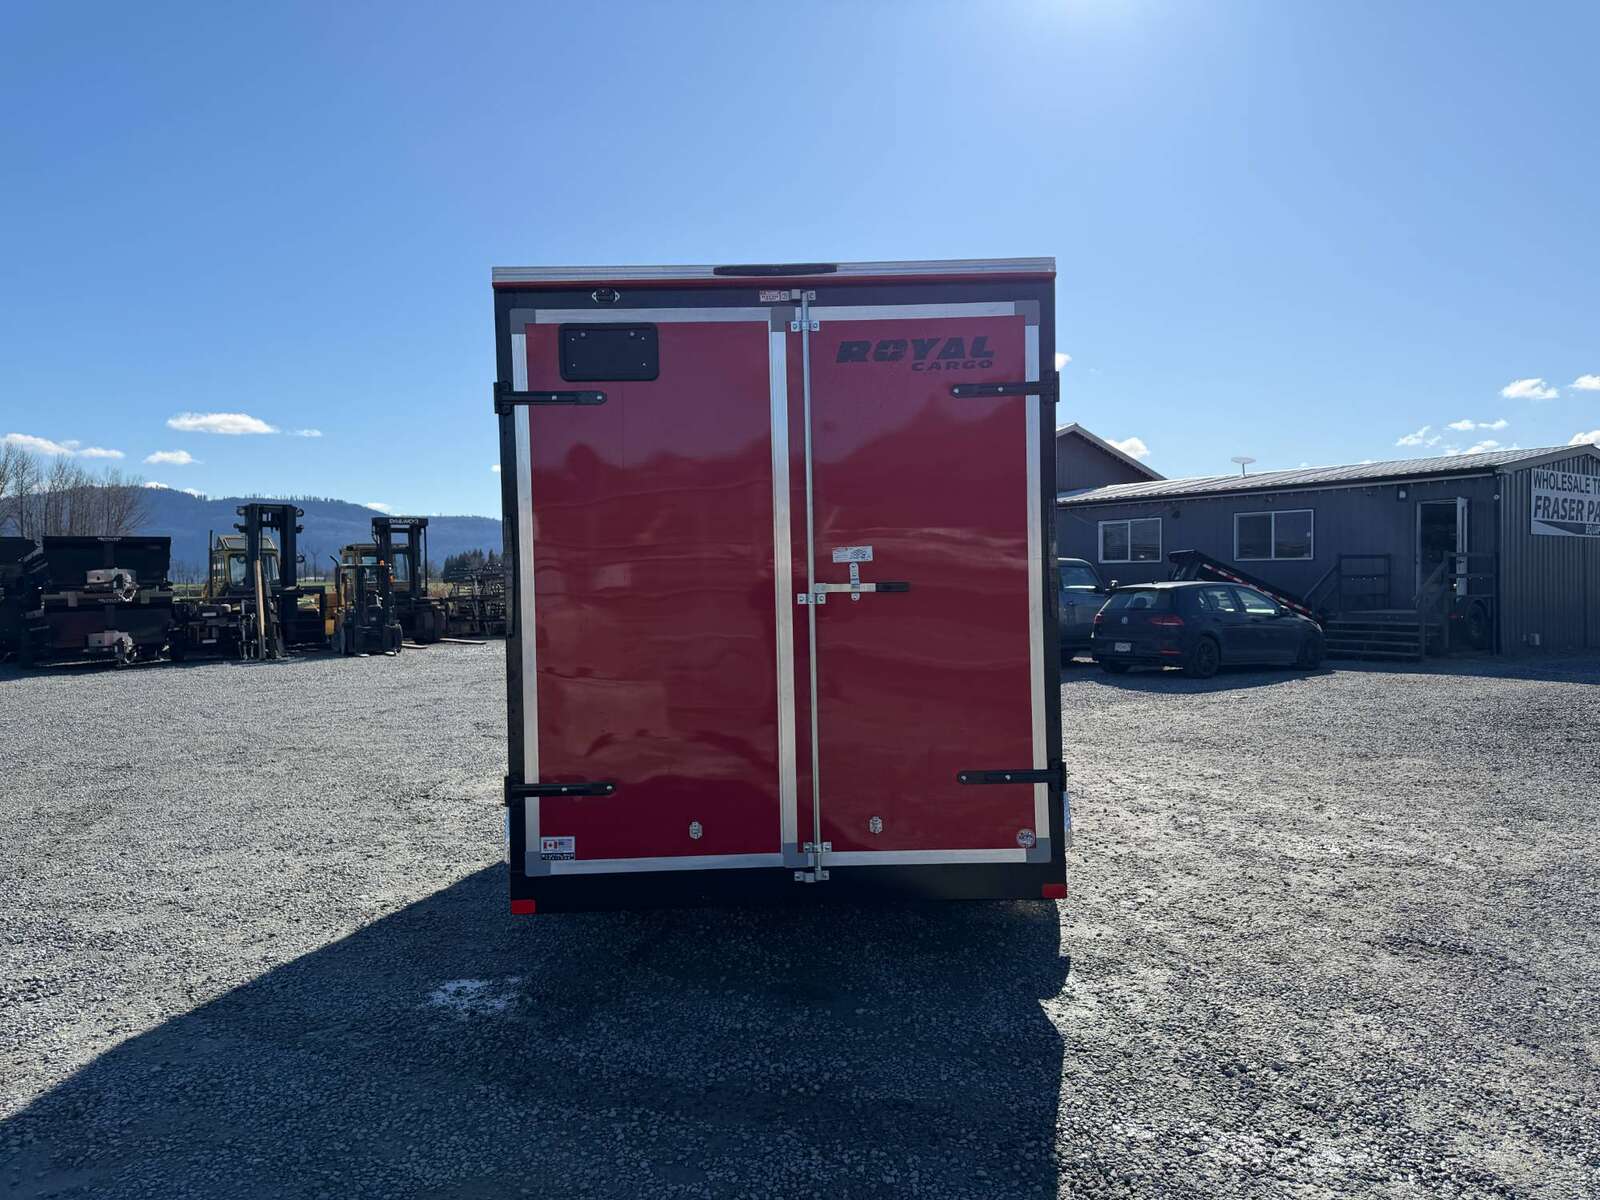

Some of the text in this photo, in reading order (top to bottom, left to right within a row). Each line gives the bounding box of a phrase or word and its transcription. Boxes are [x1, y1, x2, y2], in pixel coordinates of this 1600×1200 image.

[836, 336, 994, 363] ROYAL
[911, 360, 993, 371] CARGO
[1533, 470, 1590, 495] WHOLESALE
[1533, 495, 1584, 521] FRASER
